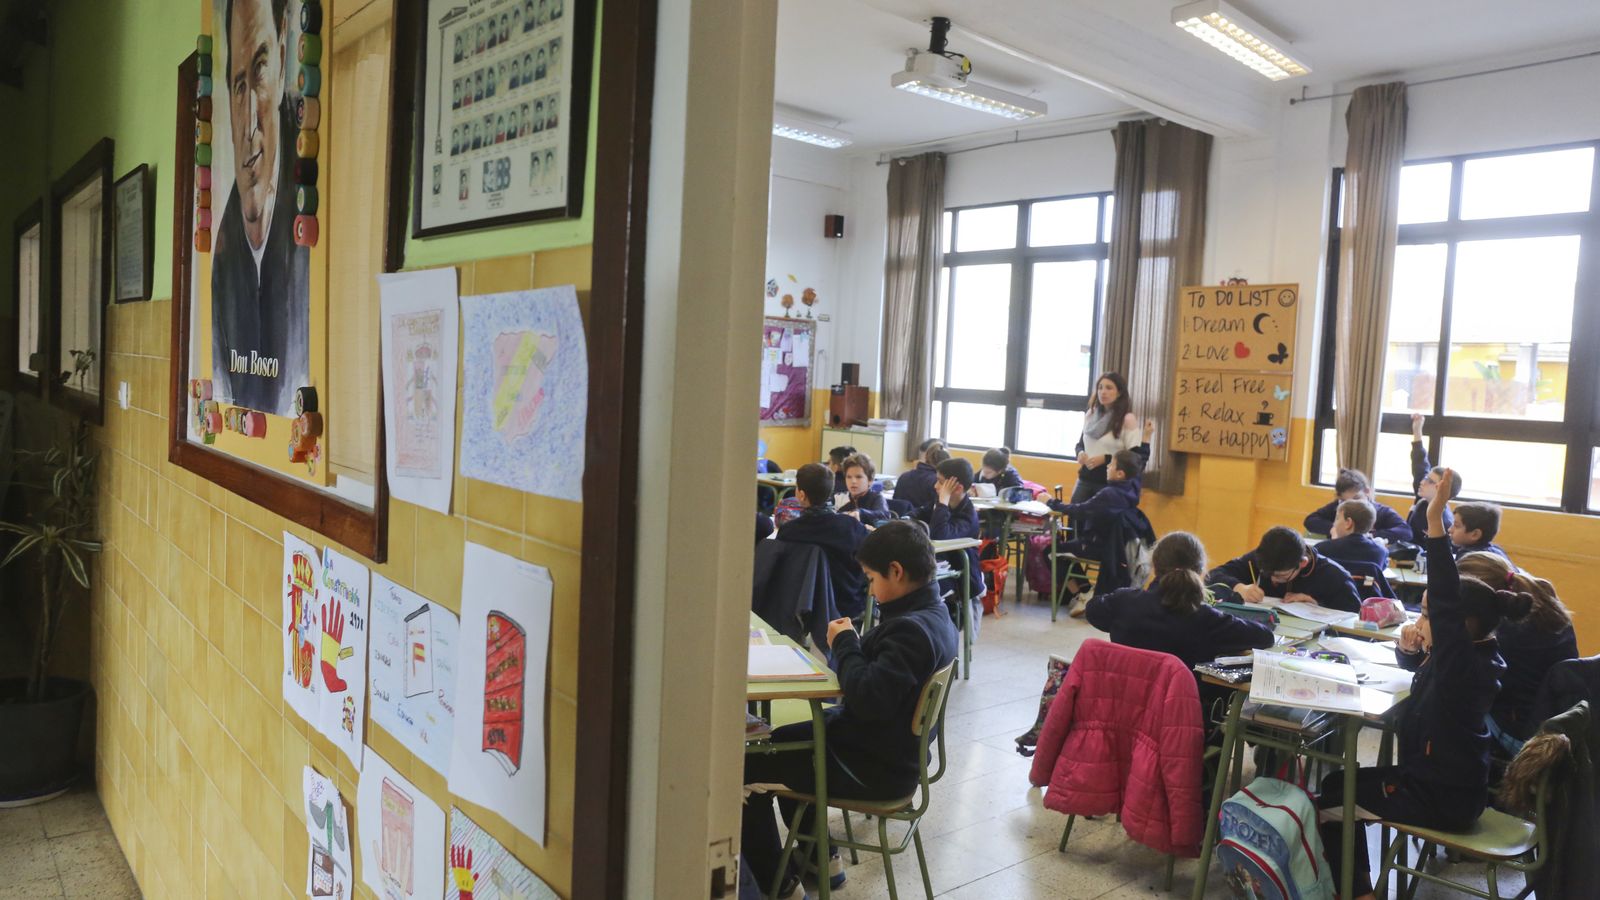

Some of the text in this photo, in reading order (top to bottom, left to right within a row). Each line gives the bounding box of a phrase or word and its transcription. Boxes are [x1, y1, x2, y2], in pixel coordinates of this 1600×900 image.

[1188, 288, 1276, 308] TO DO LIST
[1193, 316, 1245, 334] Dream
[229, 349, 279, 378] Don Bosco
[1196, 373, 1223, 394] Feel
[1233, 378, 1265, 394] Free
[1200, 402, 1245, 425] Relax
[1191, 426, 1211, 444] Be
[1219, 429, 1270, 458] Happy
